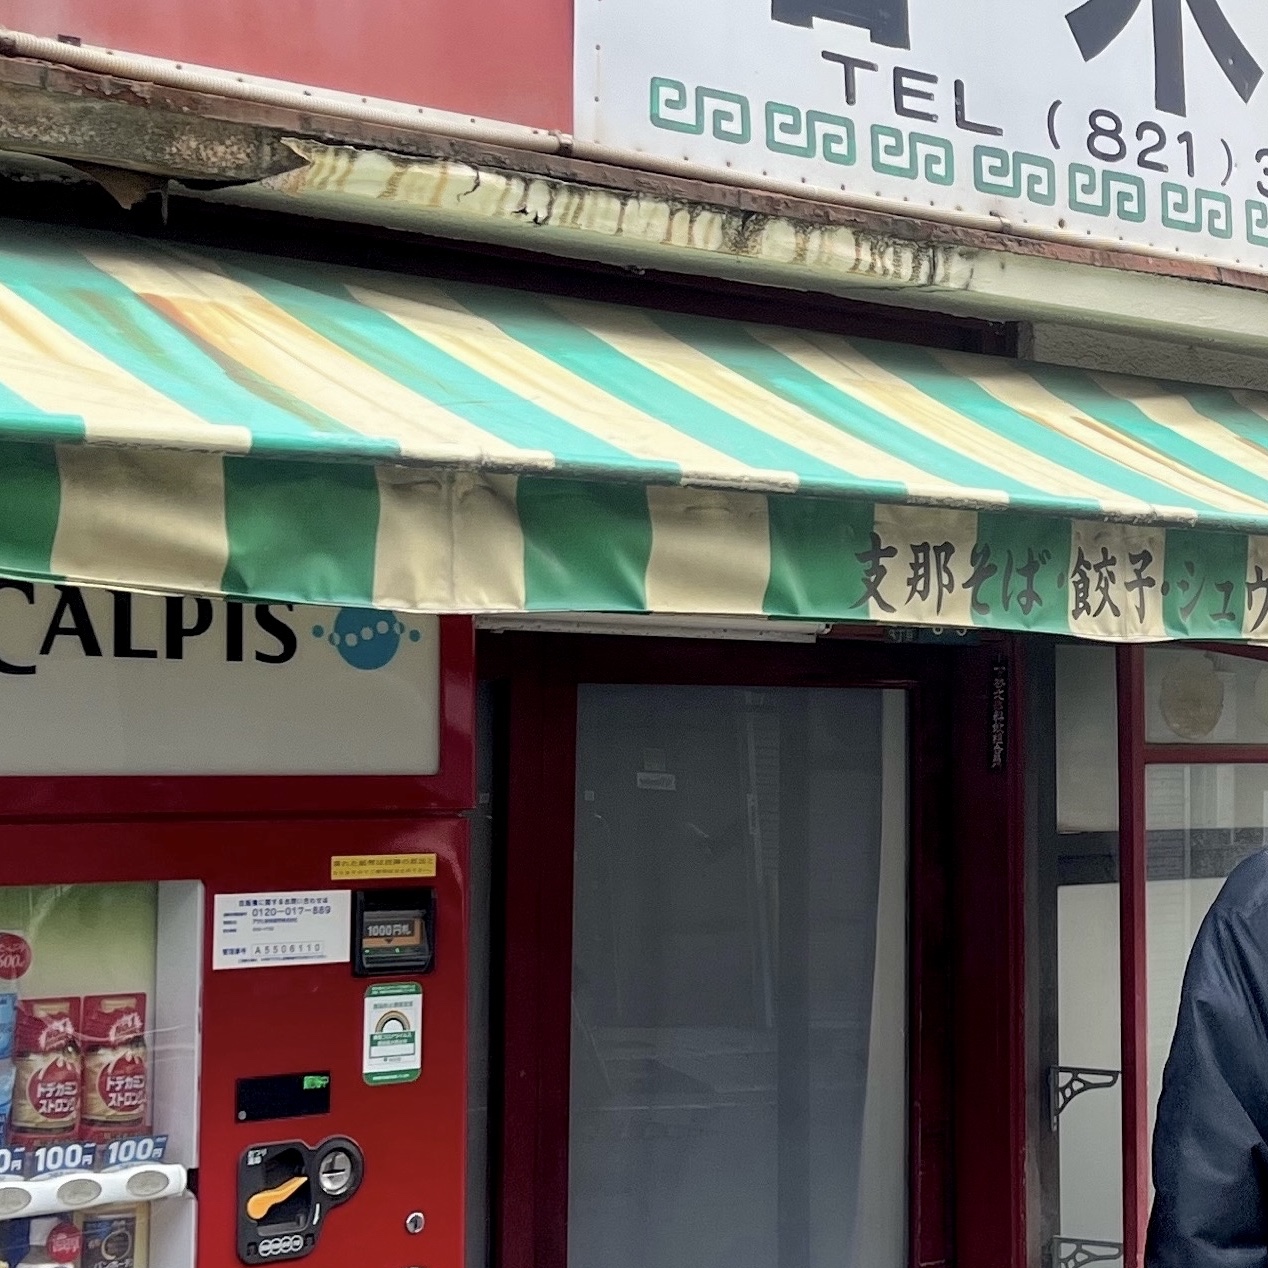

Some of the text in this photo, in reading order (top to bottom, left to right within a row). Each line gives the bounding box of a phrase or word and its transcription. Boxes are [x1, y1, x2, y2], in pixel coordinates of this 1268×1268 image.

[821, 50, 1003, 136] TEL
[35, 1144, 93, 1172] 100円
[108, 1138, 163, 1163] 100円
